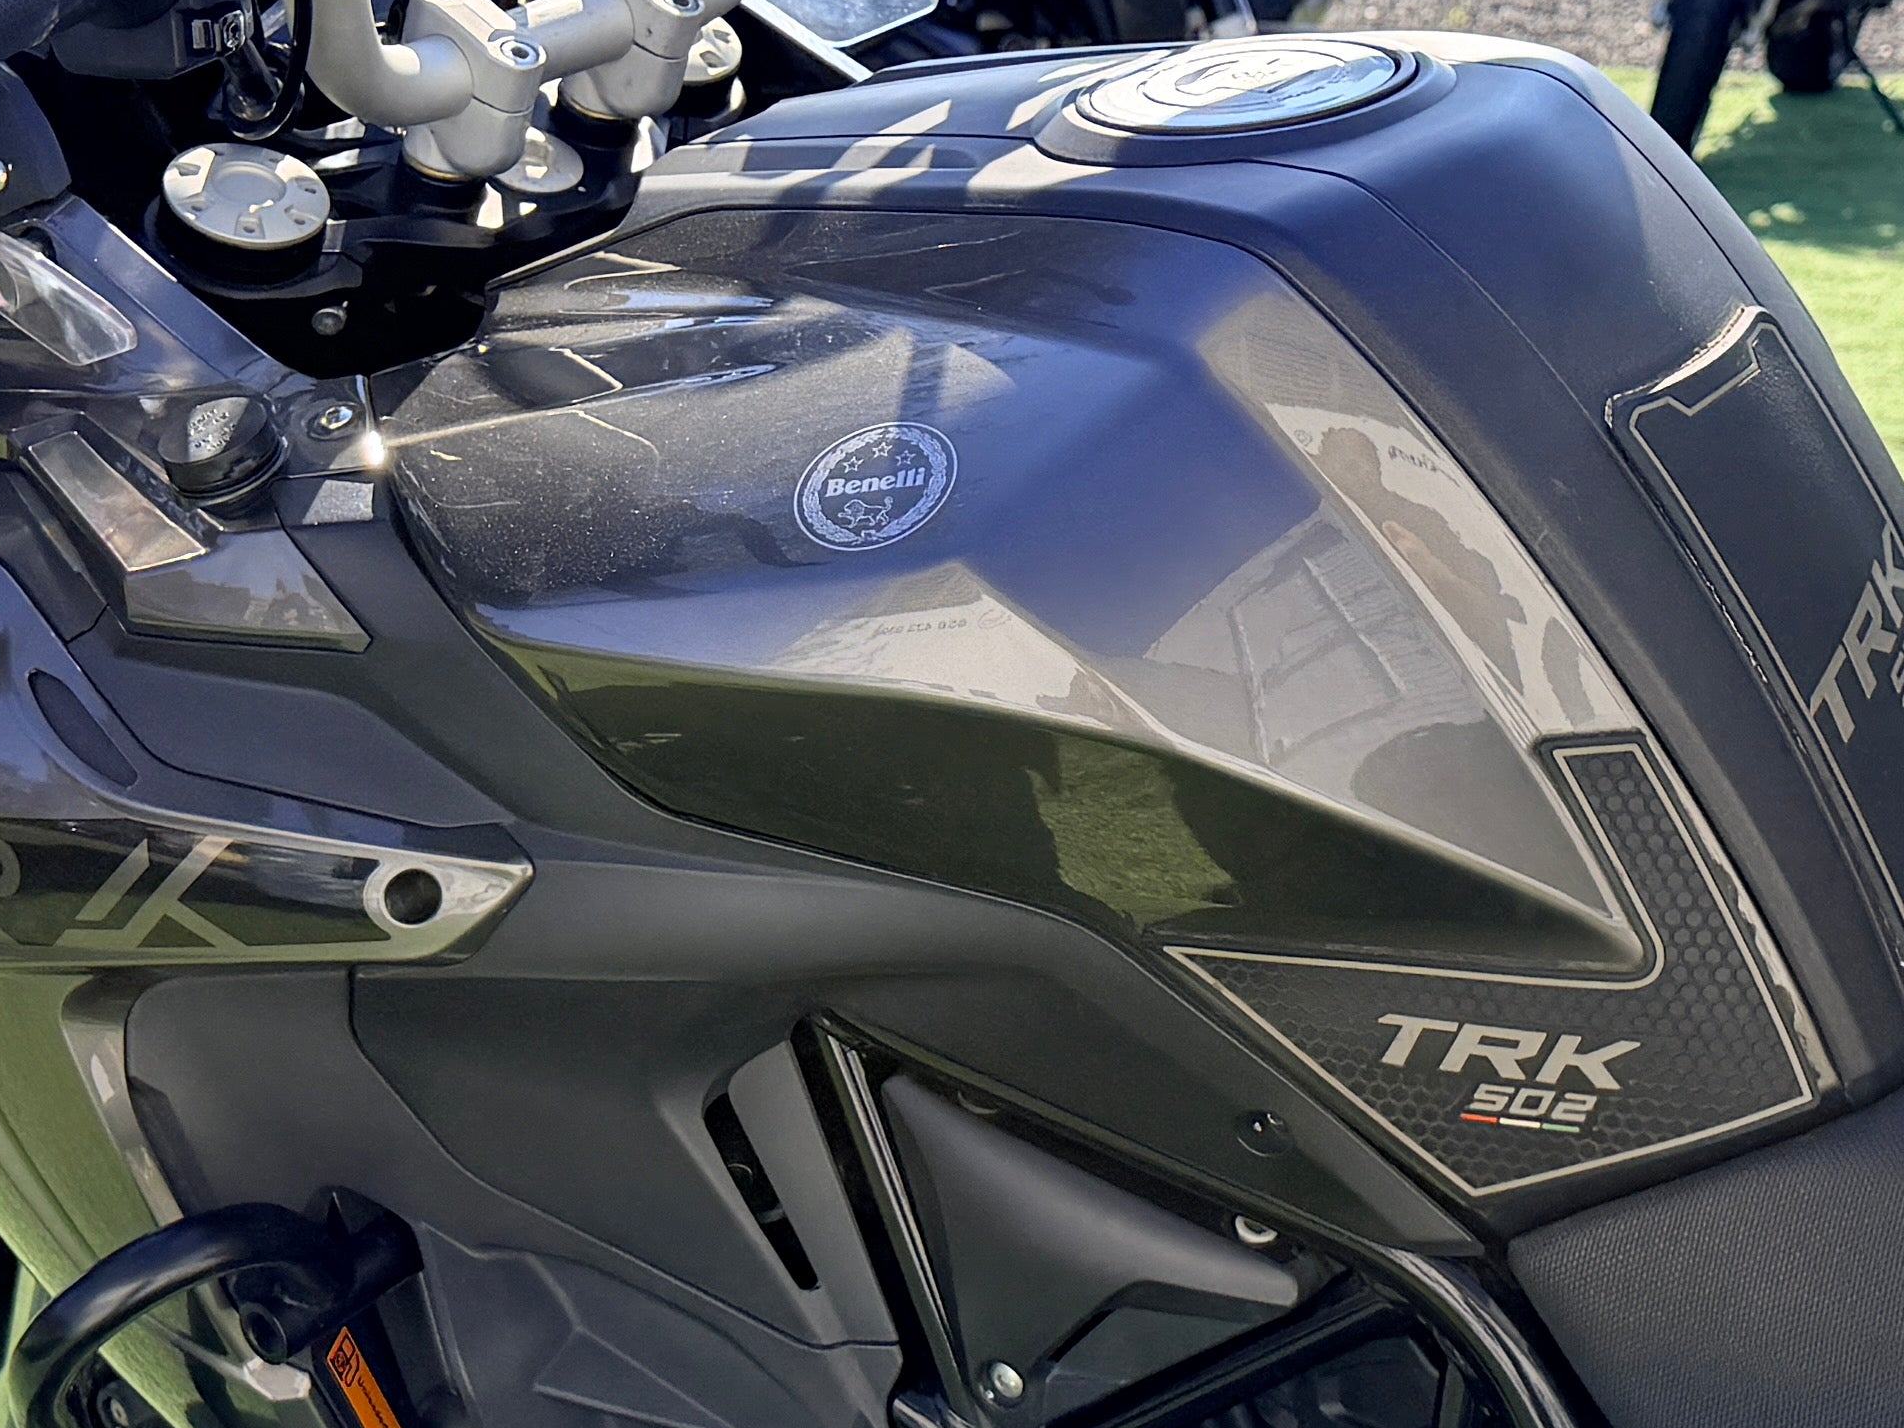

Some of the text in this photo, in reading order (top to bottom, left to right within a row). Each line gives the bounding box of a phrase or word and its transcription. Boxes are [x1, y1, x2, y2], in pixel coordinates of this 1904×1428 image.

[824, 466, 927, 498] Benelli
[1377, 1013, 1641, 1091] TRK
[1469, 1083, 1598, 1123] 502
